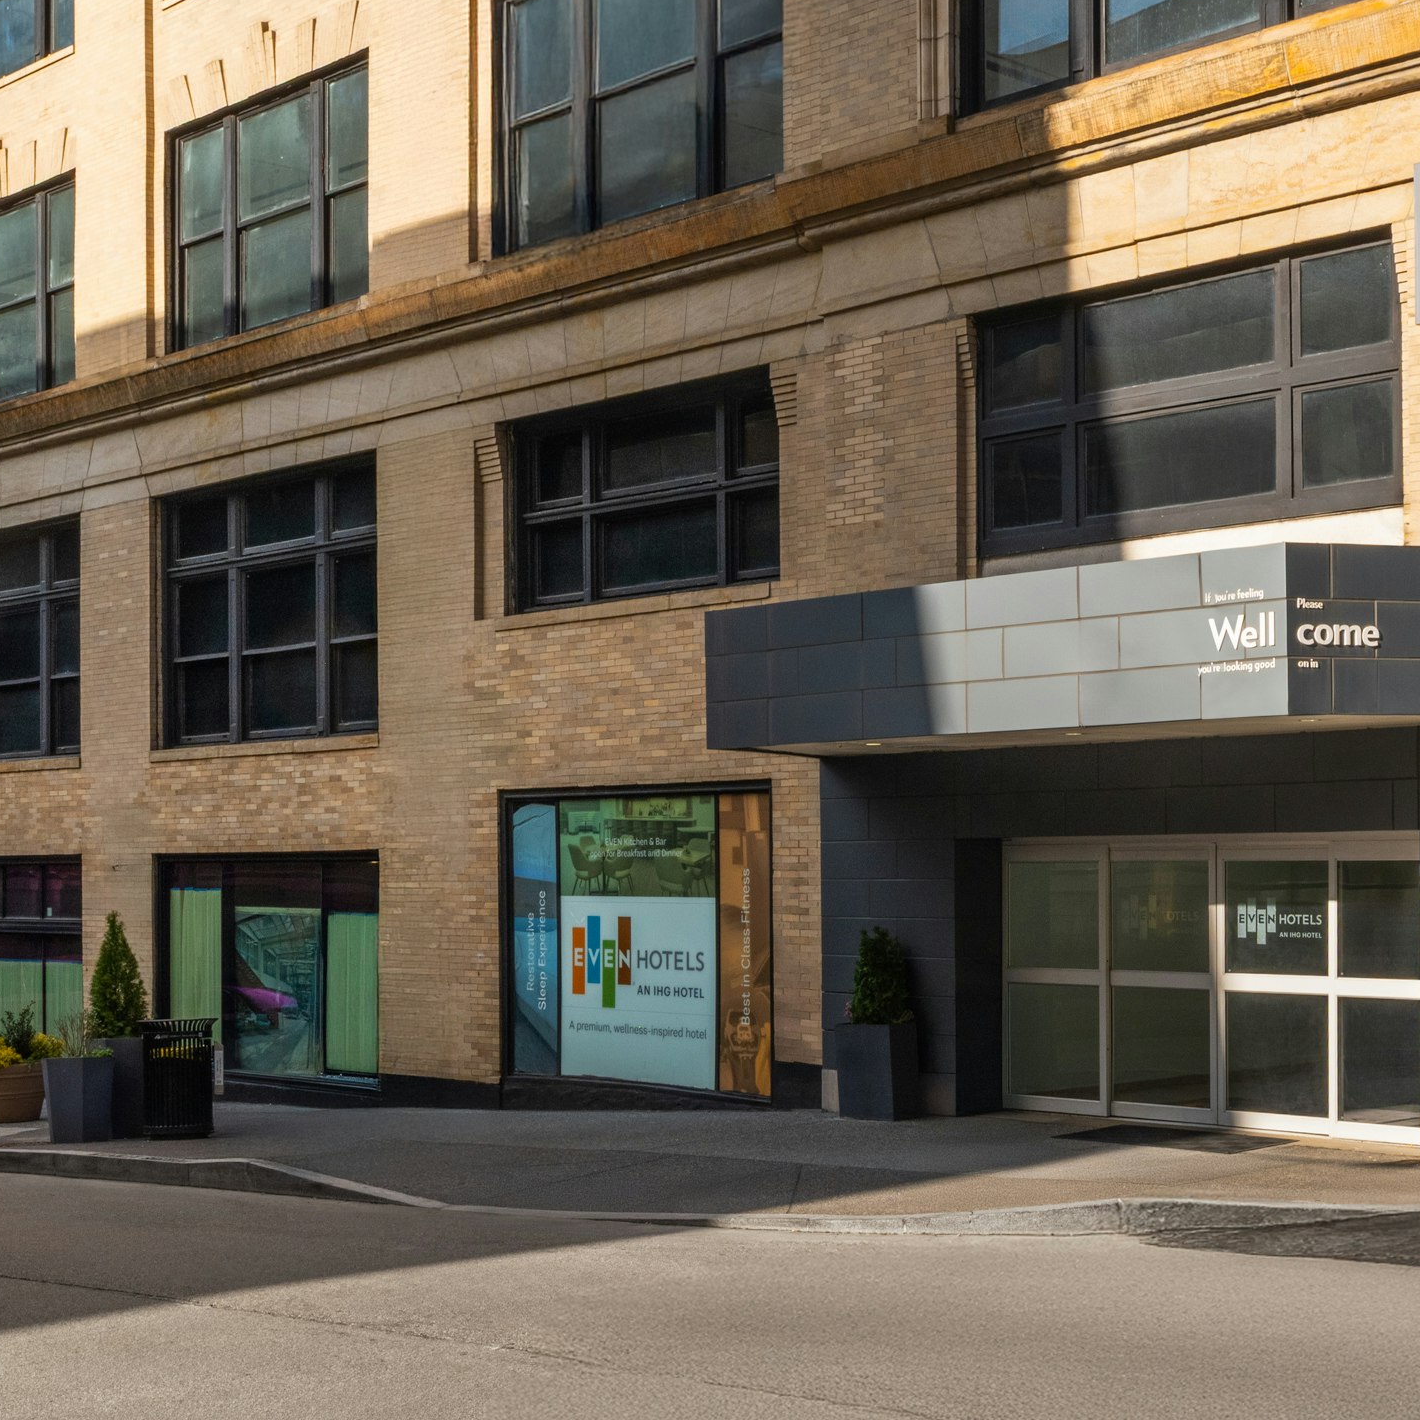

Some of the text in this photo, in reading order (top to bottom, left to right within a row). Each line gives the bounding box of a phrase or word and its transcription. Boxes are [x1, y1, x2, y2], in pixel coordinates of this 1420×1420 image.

[1237, 588, 1264, 600] feeling
[1296, 597, 1324, 610] Please
[1208, 611, 1275, 652] Well
[1297, 623, 1381, 647] come
[1197, 658, 1276, 676] you're looking good
[1297, 658, 1319, 669] on in
[604, 837, 667, 846] EVEN Kitchen & Bar
[606, 849, 616, 858] for
[616, 849, 647, 858] Breakfast
[648, 849, 660, 857] and
[661, 849, 683, 857] Dinner
[1239, 913, 1323, 925] EVEN HOTELS
[526, 912, 535, 991] Restorative
[538, 890, 548, 1011] Sleep Experience
[740, 867, 750, 1025] Best in Class Fitness
[573, 947, 705, 972] EVEN HOTELS
[636, 985, 705, 999] AN IHG HOTEL
[569, 1020, 707, 1040] A premium, wellness-inspired hotel
